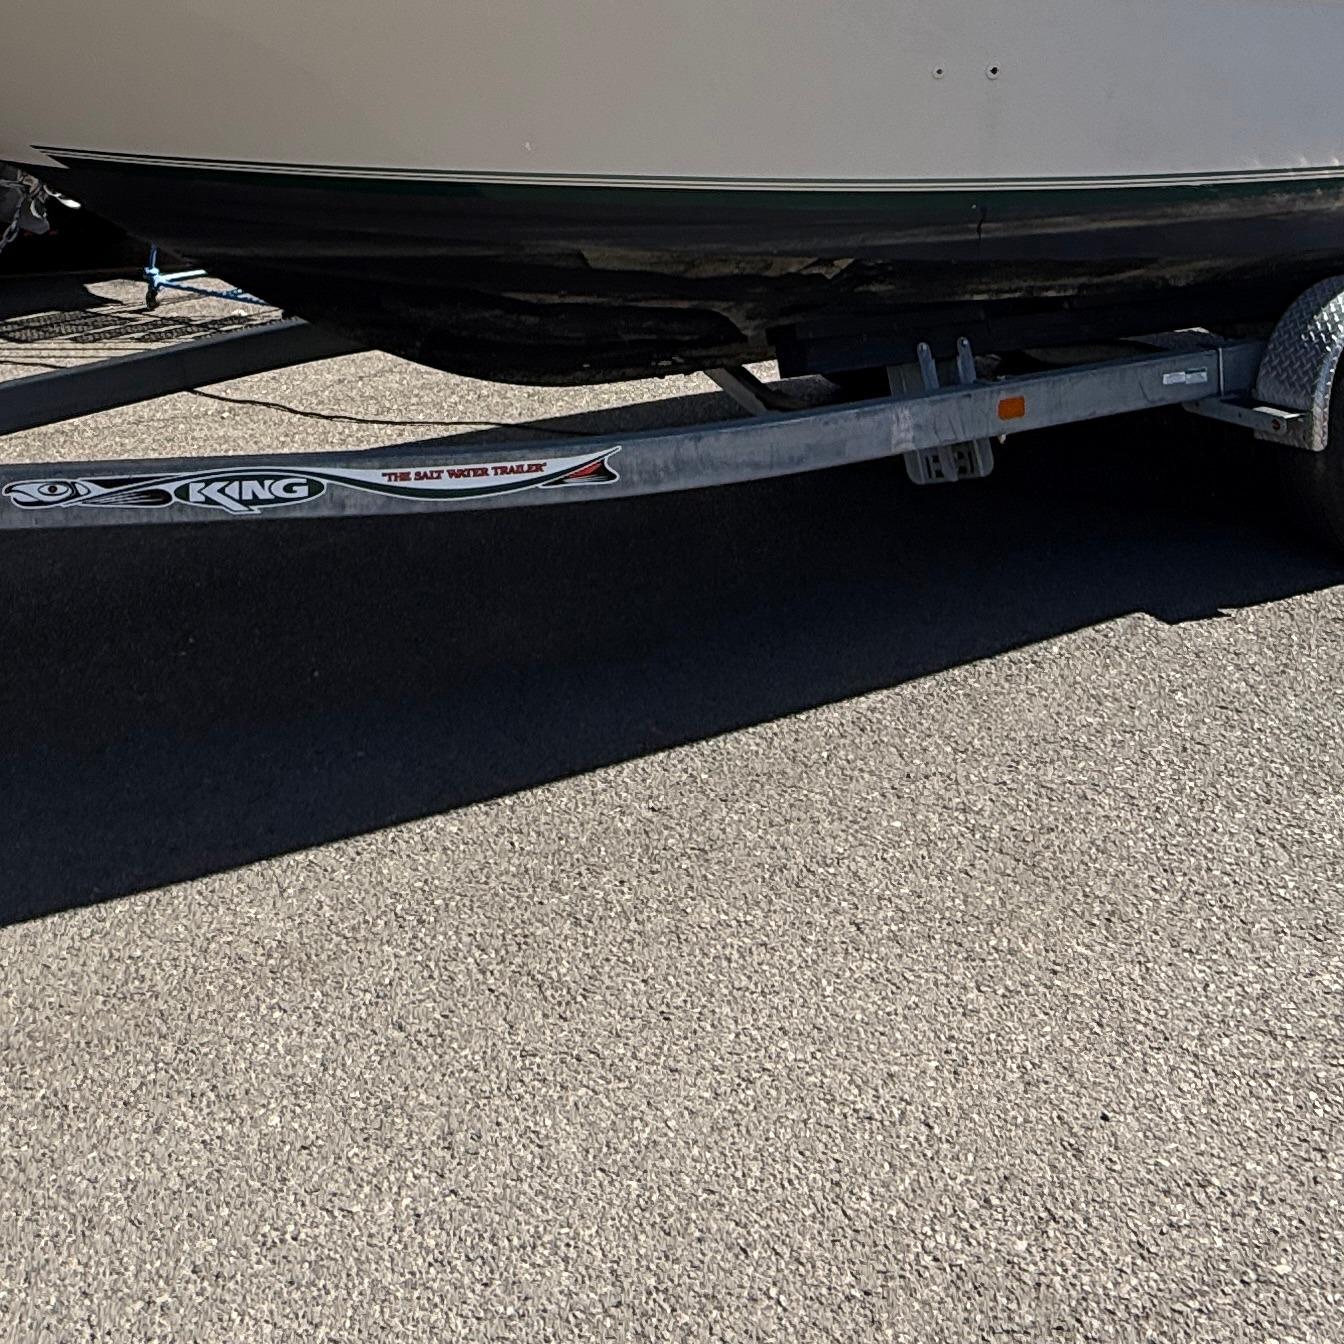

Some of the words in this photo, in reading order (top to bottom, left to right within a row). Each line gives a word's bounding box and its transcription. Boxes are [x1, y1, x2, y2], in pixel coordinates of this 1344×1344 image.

[413, 469, 444, 481] SALT
[447, 467, 490, 479] WATER
[188, 477, 309, 513] KING
